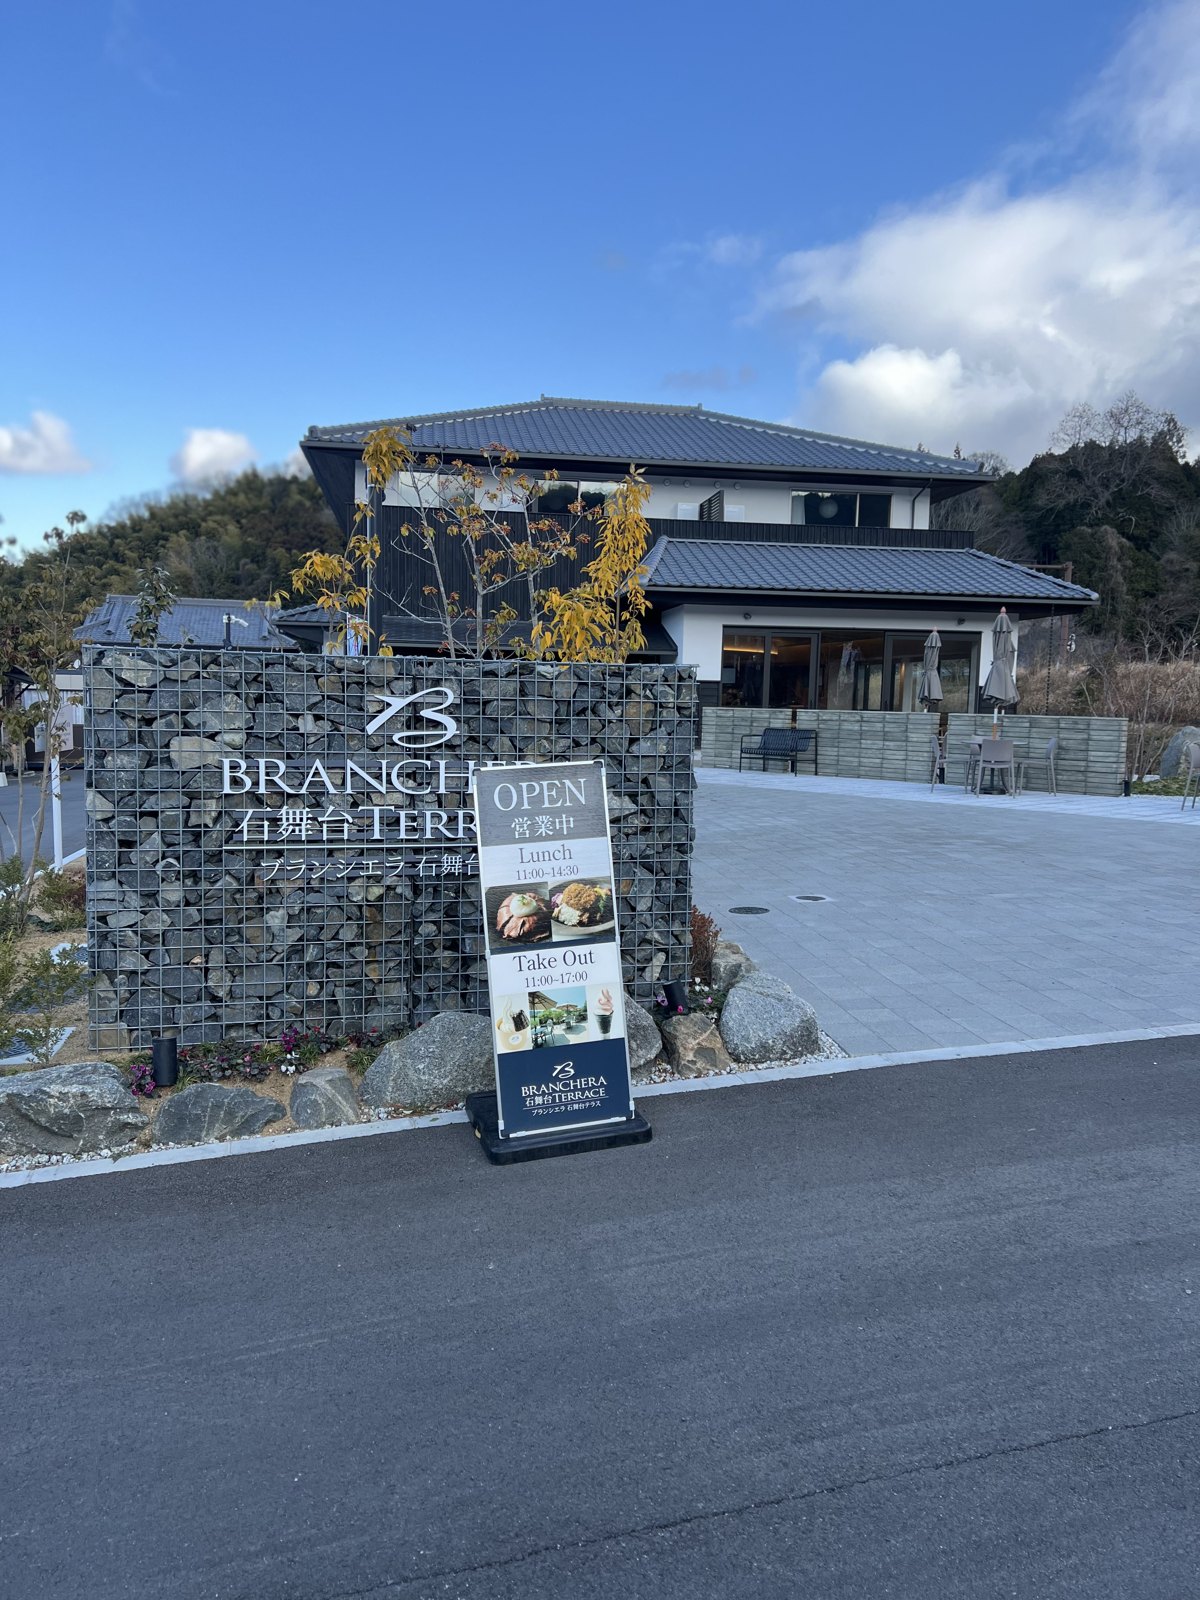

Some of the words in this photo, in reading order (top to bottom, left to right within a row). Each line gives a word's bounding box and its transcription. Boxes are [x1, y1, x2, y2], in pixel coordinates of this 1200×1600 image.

[221, 758, 536, 795] BRANCH
[493, 778, 588, 811] OPEN
[235, 805, 478, 842] 石舞台TERR
[511, 814, 574, 839] 営業中
[260, 856, 406, 882] ブランシエラ
[415, 852, 479, 878] 石舞台
[518, 844, 574, 864] Lunch
[512, 953, 558, 973] Take
[562, 949, 596, 967] Out
[521, 1075, 608, 1097] BRANCHERA
